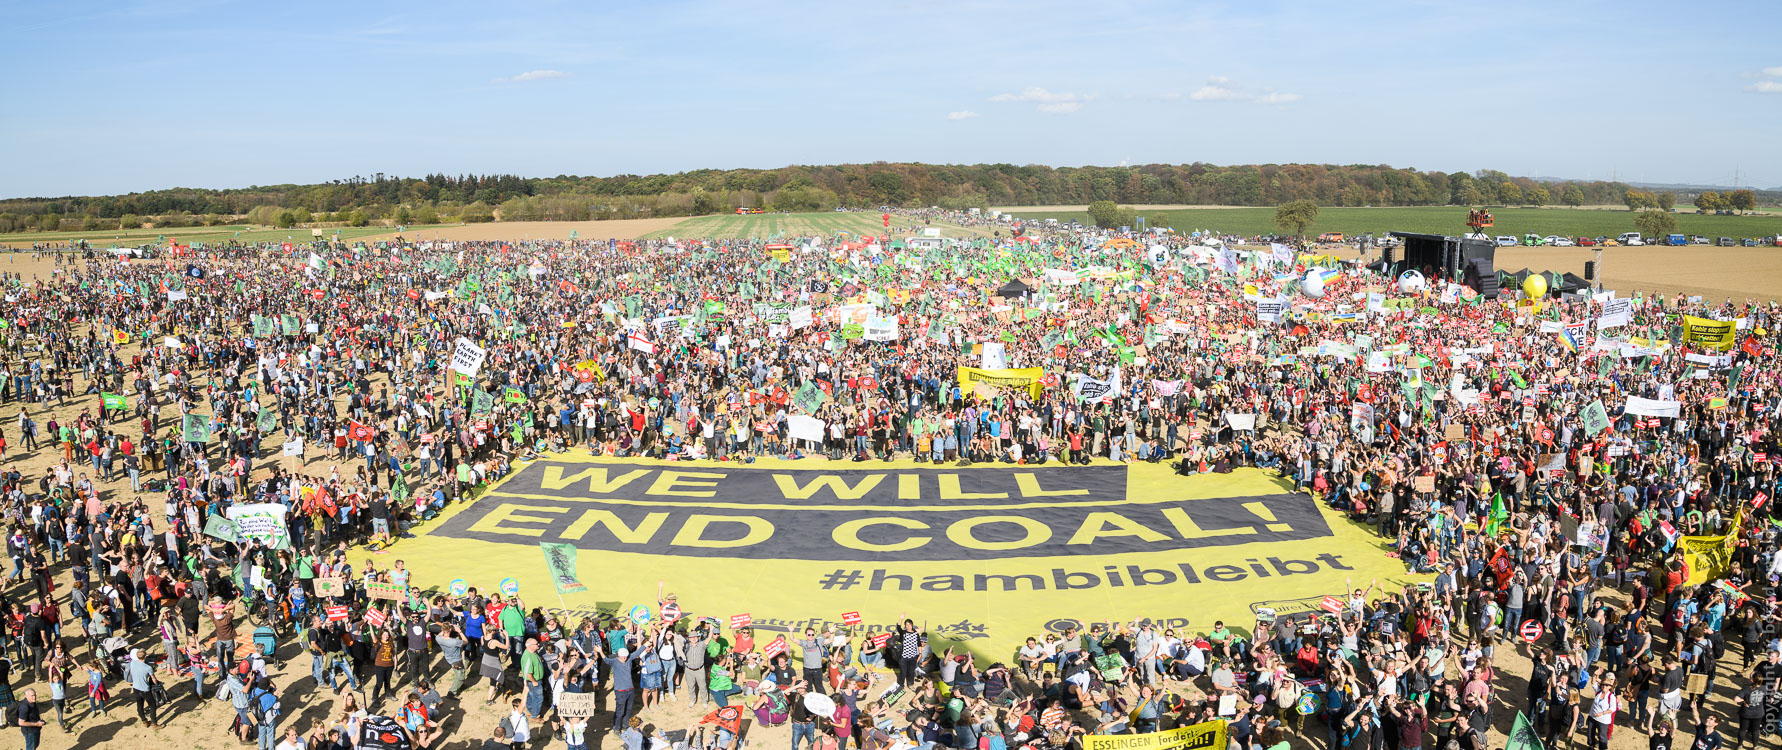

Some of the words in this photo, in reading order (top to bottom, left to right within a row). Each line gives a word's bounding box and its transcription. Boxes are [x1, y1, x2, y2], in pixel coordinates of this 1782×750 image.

[1708, 326, 1730, 334] stoppen!
[456, 349, 475, 363] EARTH
[460, 342, 482, 358] PLANET
[454, 355, 473, 369] FIRST
[540, 465, 728, 498] WE
[771, 472, 1091, 500] WILL
[466, 502, 775, 548] END
[831, 501, 1294, 552] COAL!
[819, 551, 1354, 591] #hambibleibt
